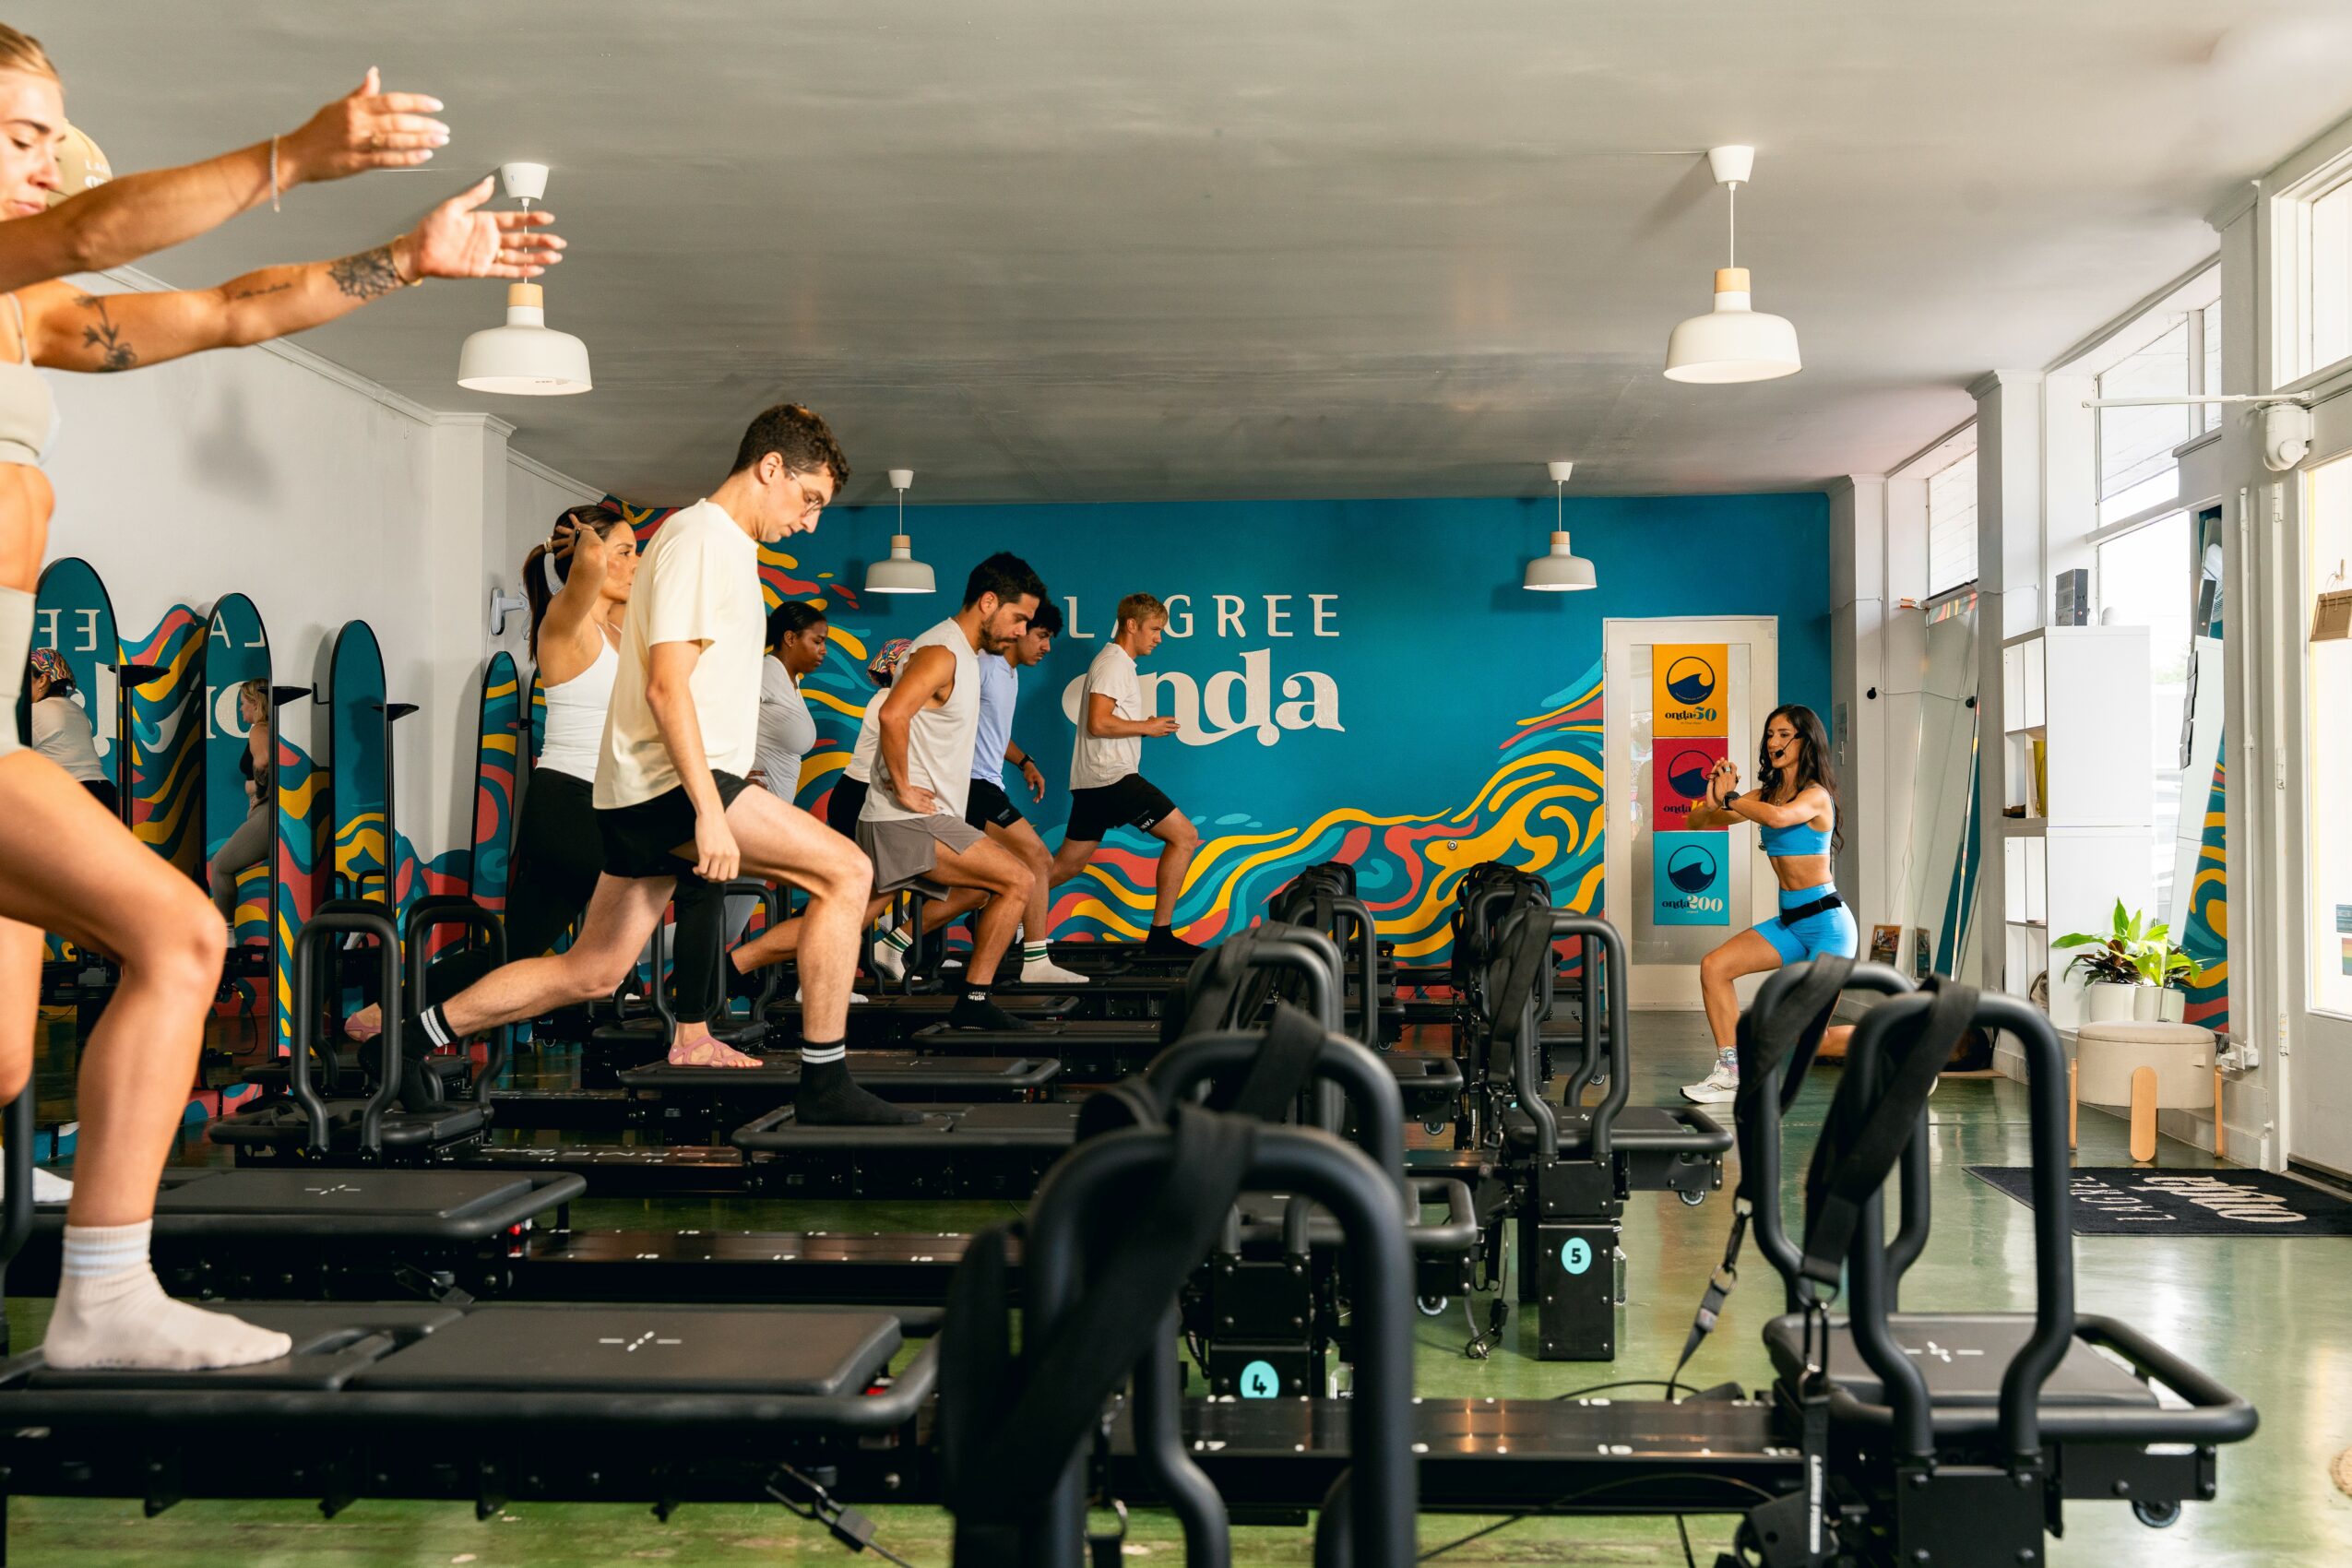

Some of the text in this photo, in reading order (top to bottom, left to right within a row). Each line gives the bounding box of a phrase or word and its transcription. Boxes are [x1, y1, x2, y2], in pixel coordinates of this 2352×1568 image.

[1063, 593, 1340, 639] LGREE
[2128, 1176, 2308, 1223] onda
[1571, 1247, 1583, 1265] 5
[1252, 1373, 1267, 1396] 4
